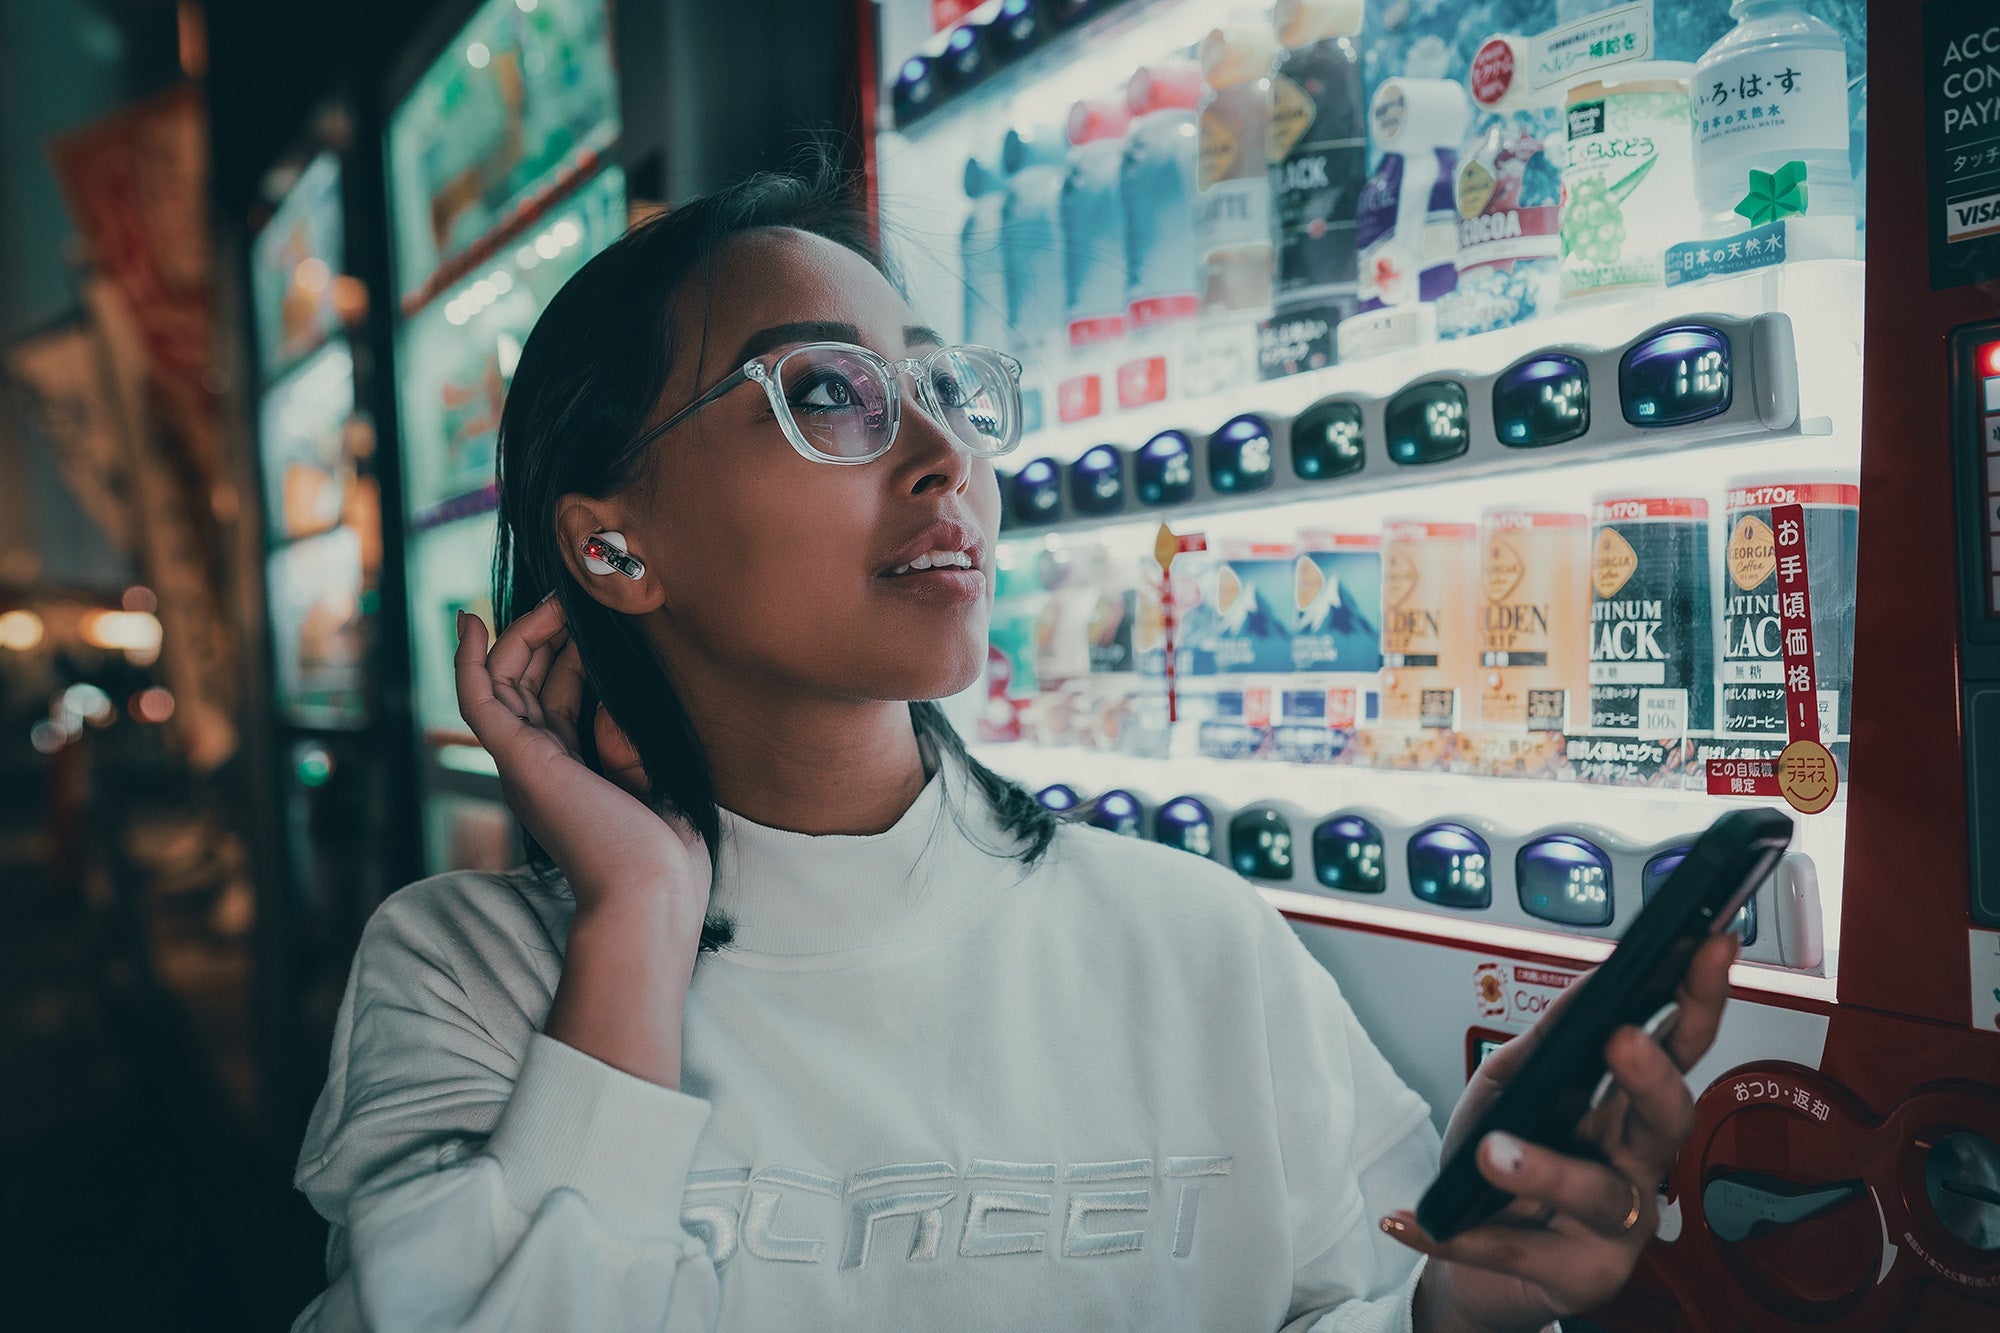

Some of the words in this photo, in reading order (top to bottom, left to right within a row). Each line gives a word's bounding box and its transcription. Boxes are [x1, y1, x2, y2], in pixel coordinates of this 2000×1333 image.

[1943, 27, 2000, 67] ACC
[1702, 103, 1780, 134] 日本の天然水
[1758, 119, 1785, 128] WATER
[1944, 97, 2000, 134] PAY
[1954, 200, 2000, 227] VISA
[1684, 233, 1783, 271] 日本の天然水
[1777, 519, 1812, 728] お手頃価格！
[1711, 762, 1774, 777] この自販機
[1787, 757, 1826, 769] ニコニコ
[1787, 770, 1827, 783] プライス
[1731, 778, 1756, 793] 限定
[1734, 1080, 1830, 1121] おつり・返却
